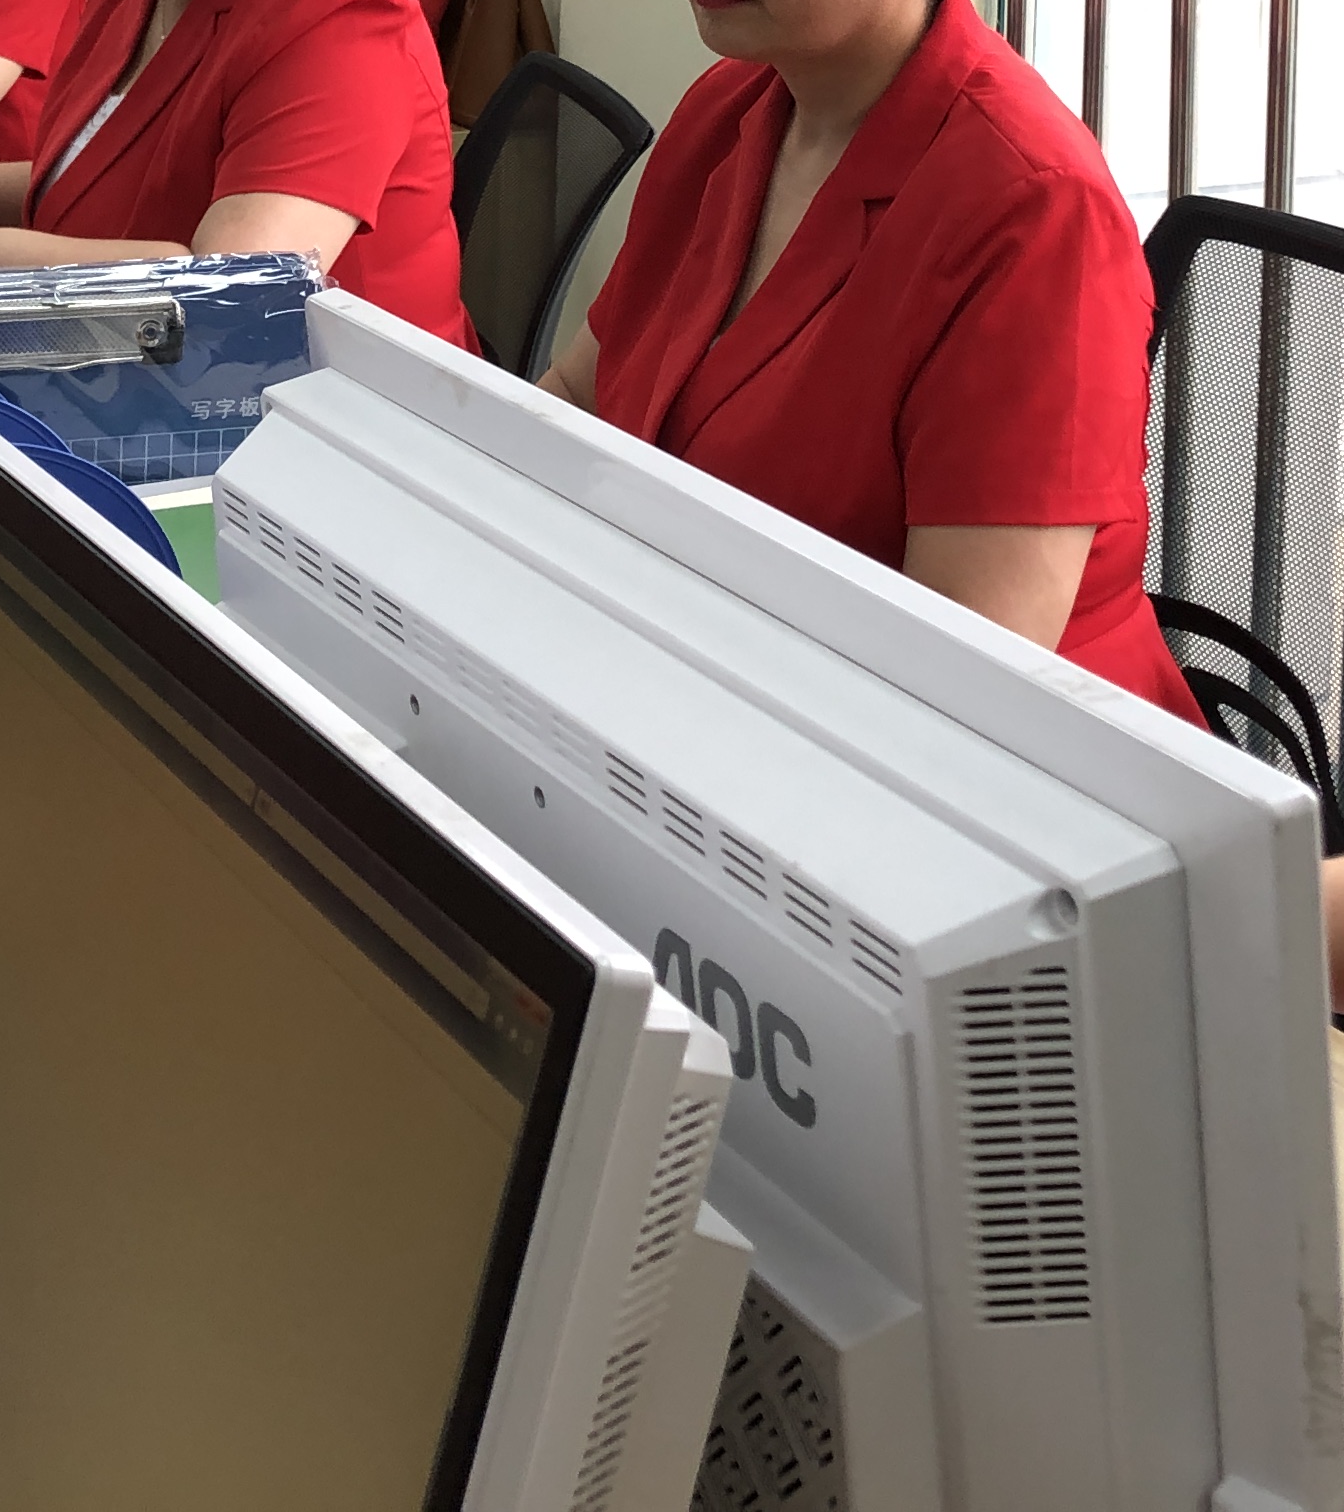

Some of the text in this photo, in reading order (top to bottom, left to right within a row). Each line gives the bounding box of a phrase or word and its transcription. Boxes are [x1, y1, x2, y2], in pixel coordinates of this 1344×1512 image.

[190, 396, 260, 420] 写字板
[653, 927, 817, 1129] AOC
